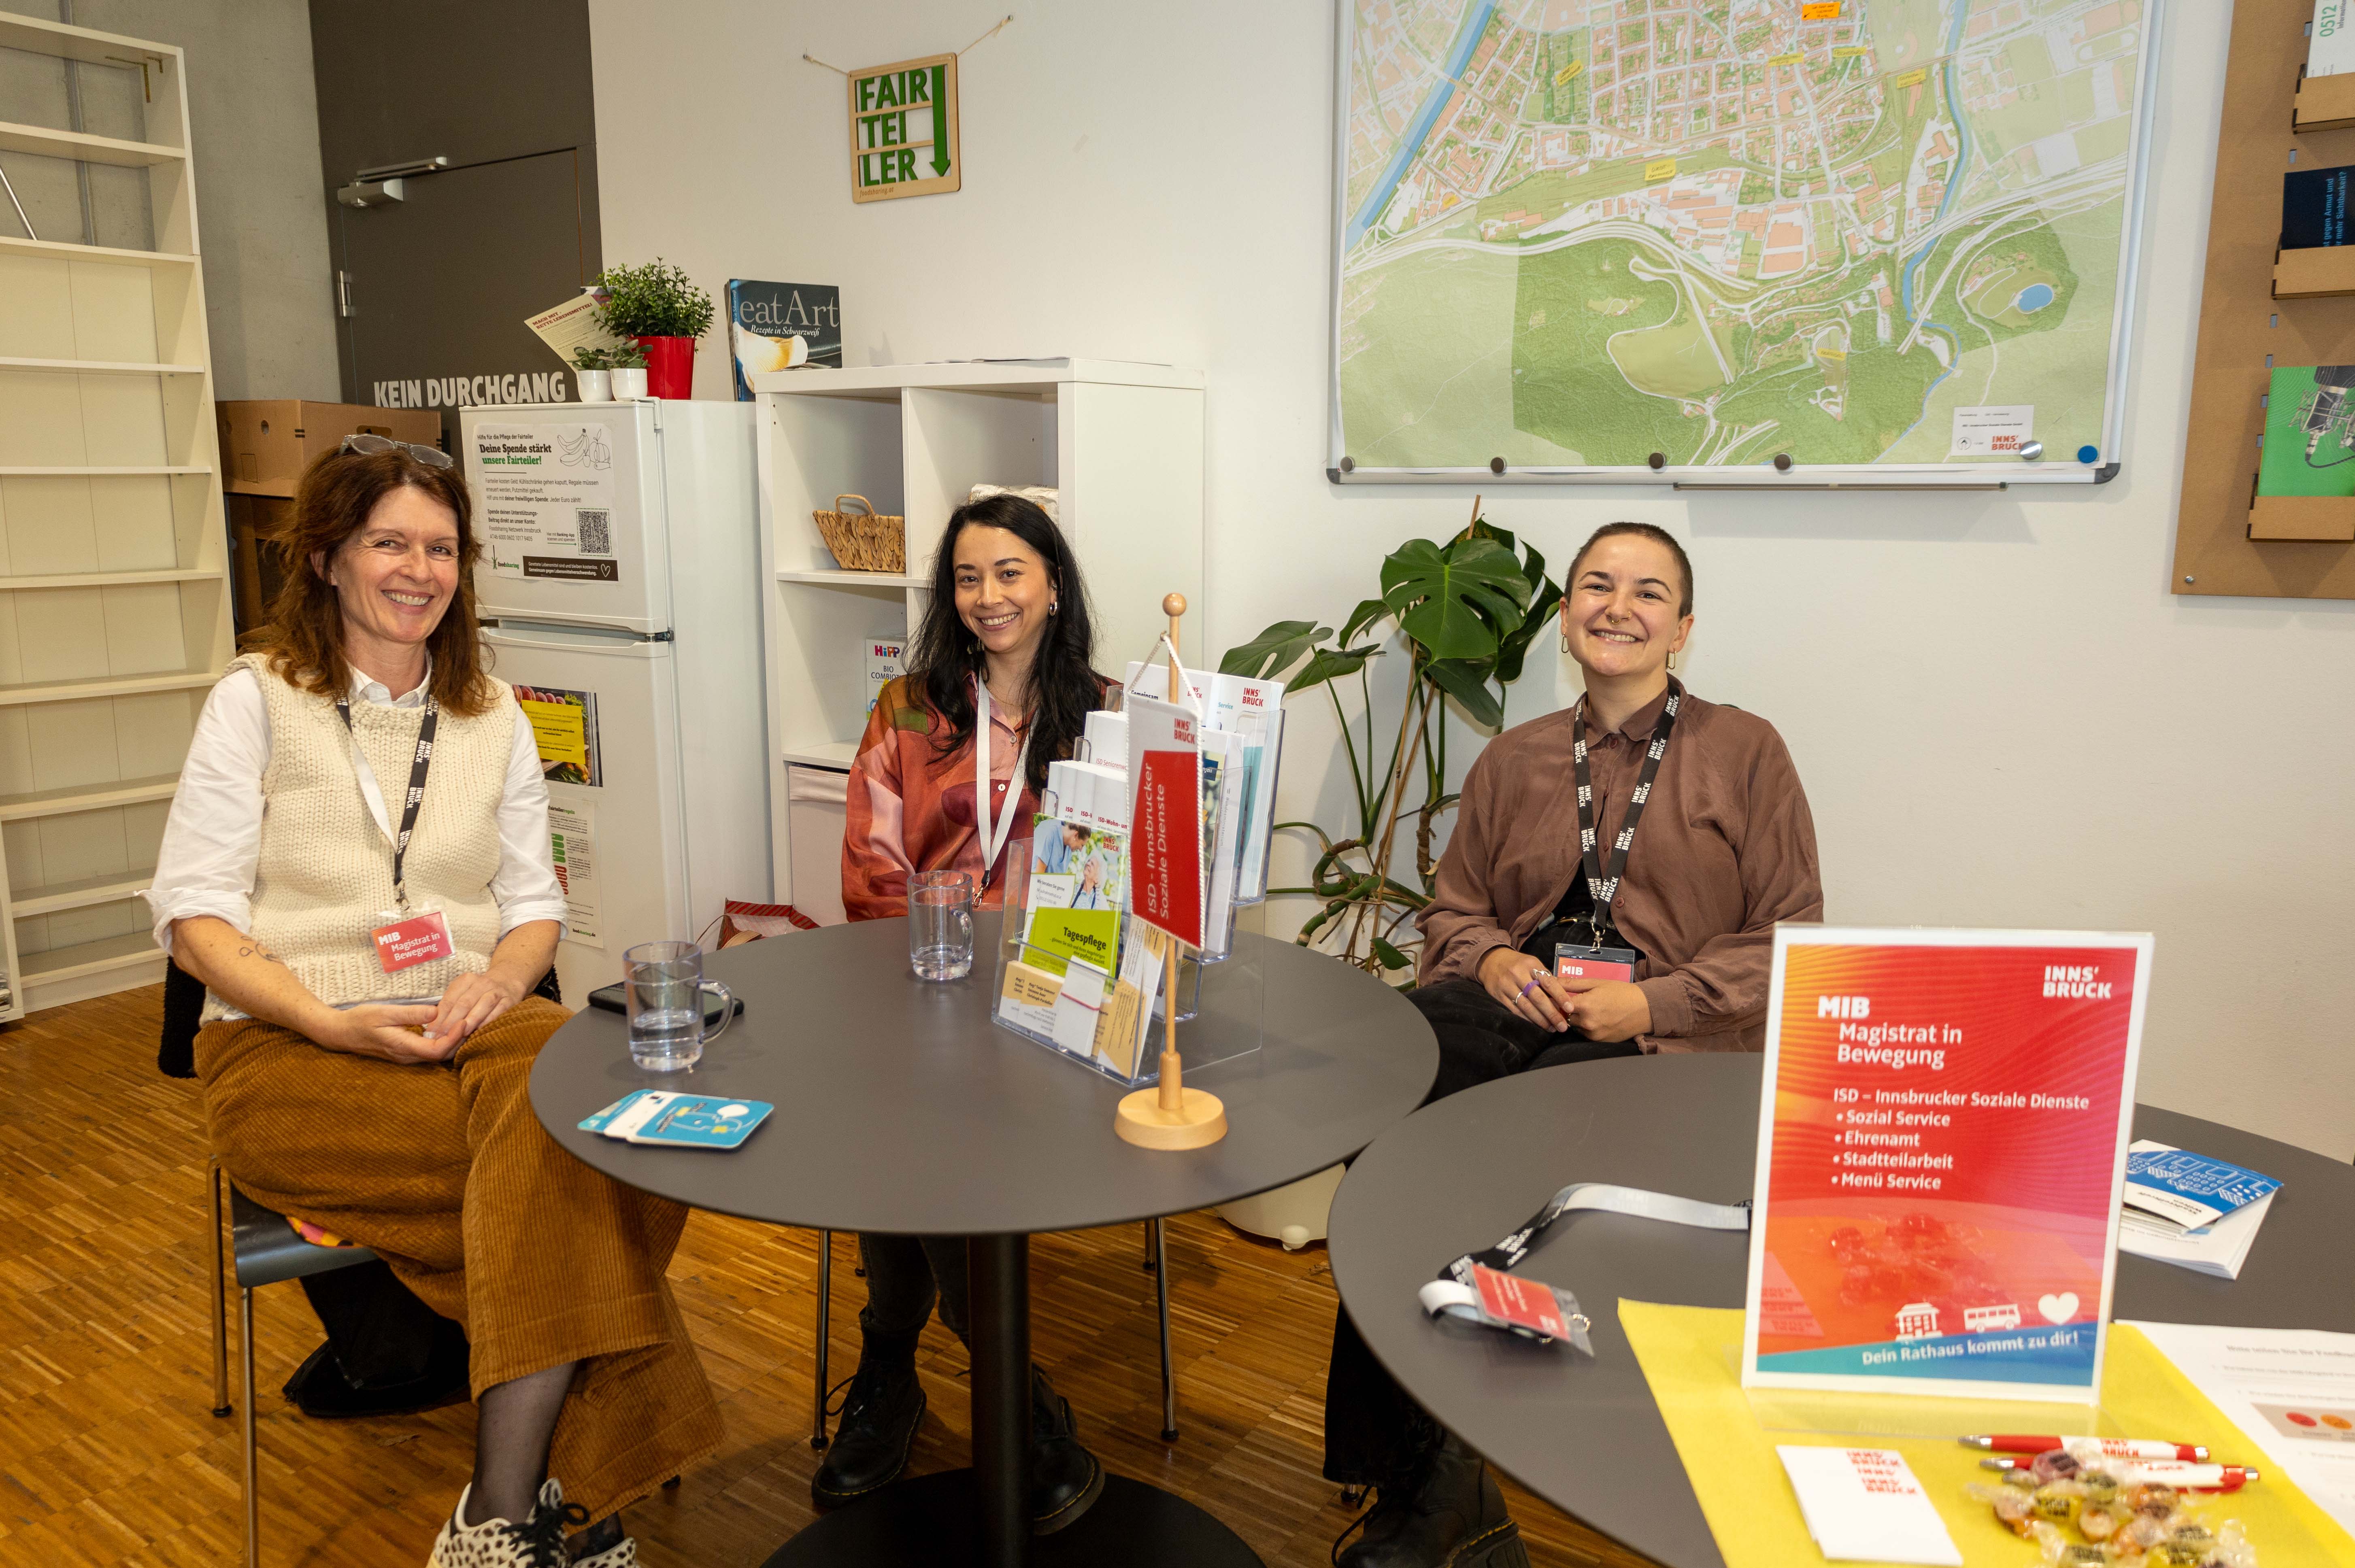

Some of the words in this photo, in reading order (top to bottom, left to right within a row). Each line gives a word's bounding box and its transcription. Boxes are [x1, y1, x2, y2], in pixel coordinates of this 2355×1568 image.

[2319, 4, 2338, 37] 0512
[860, 68, 930, 112] FAIR
[861, 110, 906, 149] TEI
[863, 148, 918, 187] LER
[859, 187, 893, 198] foodsharing.at
[2324, 194, 2332, 216] Armut
[536, 321, 553, 329] RETTE
[553, 303, 593, 323] LEBENSMITTEL!
[740, 290, 839, 327] eatArt
[532, 316, 548, 326] MACH
[751, 325, 773, 335] Rezepte
[782, 327, 819, 337] Schwarzweiß
[374, 380, 422, 408] KEIN
[427, 372, 566, 408] DURCHGANG
[479, 444, 501, 453] Deine
[502, 444, 527, 455] Spende
[529, 444, 551, 453] stärkt
[507, 456, 542, 464] Fairteiler!
[498, 561, 519, 569] foodsharing
[874, 645, 900, 658] HiPP
[1242, 696, 1263, 707] BRUCK
[1244, 688, 1260, 697] INNS'
[1665, 696, 1673, 713] INNS'
[1670, 695, 1679, 717] BRUCK
[1174, 718, 1190, 730] INNS'
[1174, 729, 1195, 744] BRUCK
[415, 740, 426, 763] BRUCK
[424, 742, 432, 760] INNS'
[1648, 739, 1659, 758] INNS'
[1654, 738, 1667, 760] BRUCK
[406, 787, 417, 809] BRUCK
[415, 788, 423, 803] INNS'
[1631, 785, 1642, 803] INNS'
[1638, 782, 1651, 804] BRUCK
[1098, 817, 1120, 826] ISD-Wohn-
[1144, 763, 1155, 869] Innsbrucker
[1157, 784, 1166, 852] Dienste
[1103, 836, 1116, 844] INNS'
[1581, 829, 1590, 852] BRUCK
[1588, 828, 1596, 845] INNS'
[1615, 831, 1625, 849] INNS'
[1622, 827, 1635, 850] BRUCK
[1103, 842, 1119, 852] BRUCK
[1159, 857, 1169, 920] Soziale
[1588, 878, 1598, 900] BRUCK
[1600, 879, 1610, 899] INNS'
[1604, 876, 1619, 902] BRUCK
[1148, 884, 1156, 914] ISD
[378, 932, 401, 945] MIB
[391, 935, 431, 952] Magistrat
[1064, 926, 1106, 951] Tagespflege
[394, 944, 438, 961] Bewegung
[1562, 965, 1583, 975] MIB
[2044, 965, 2099, 982] INNS'
[2042, 981, 2112, 999] BRUCK
[1818, 995, 1870, 1020] MIB
[1839, 1022, 1937, 1047] Magistrat
[1943, 1024, 1962, 1044] in
[1837, 1044, 1945, 1070] Bewegung
[1833, 1088, 1859, 1103] ISD
[1876, 1089, 1967, 1107] Innsbrucker
[1970, 1091, 2025, 1108] Soziale
[2031, 1093, 2090, 1110] Dienste
[1846, 1109, 1892, 1125] Sozial
[1895, 1111, 1951, 1127] Service
[1844, 1130, 1920, 1147] Ehrenamt
[1843, 1151, 1953, 1169] Stadtteilarbeit
[1841, 1173, 1883, 1188] Menü
[1887, 1173, 1942, 1190] Service
[1862, 1350, 1897, 1365] Dein
[1901, 1343, 1964, 1361] Rathaus
[1967, 1336, 2024, 1354] kommt
[2027, 1336, 2047, 1349] zu
[2050, 1330, 2079, 1347] dir!
